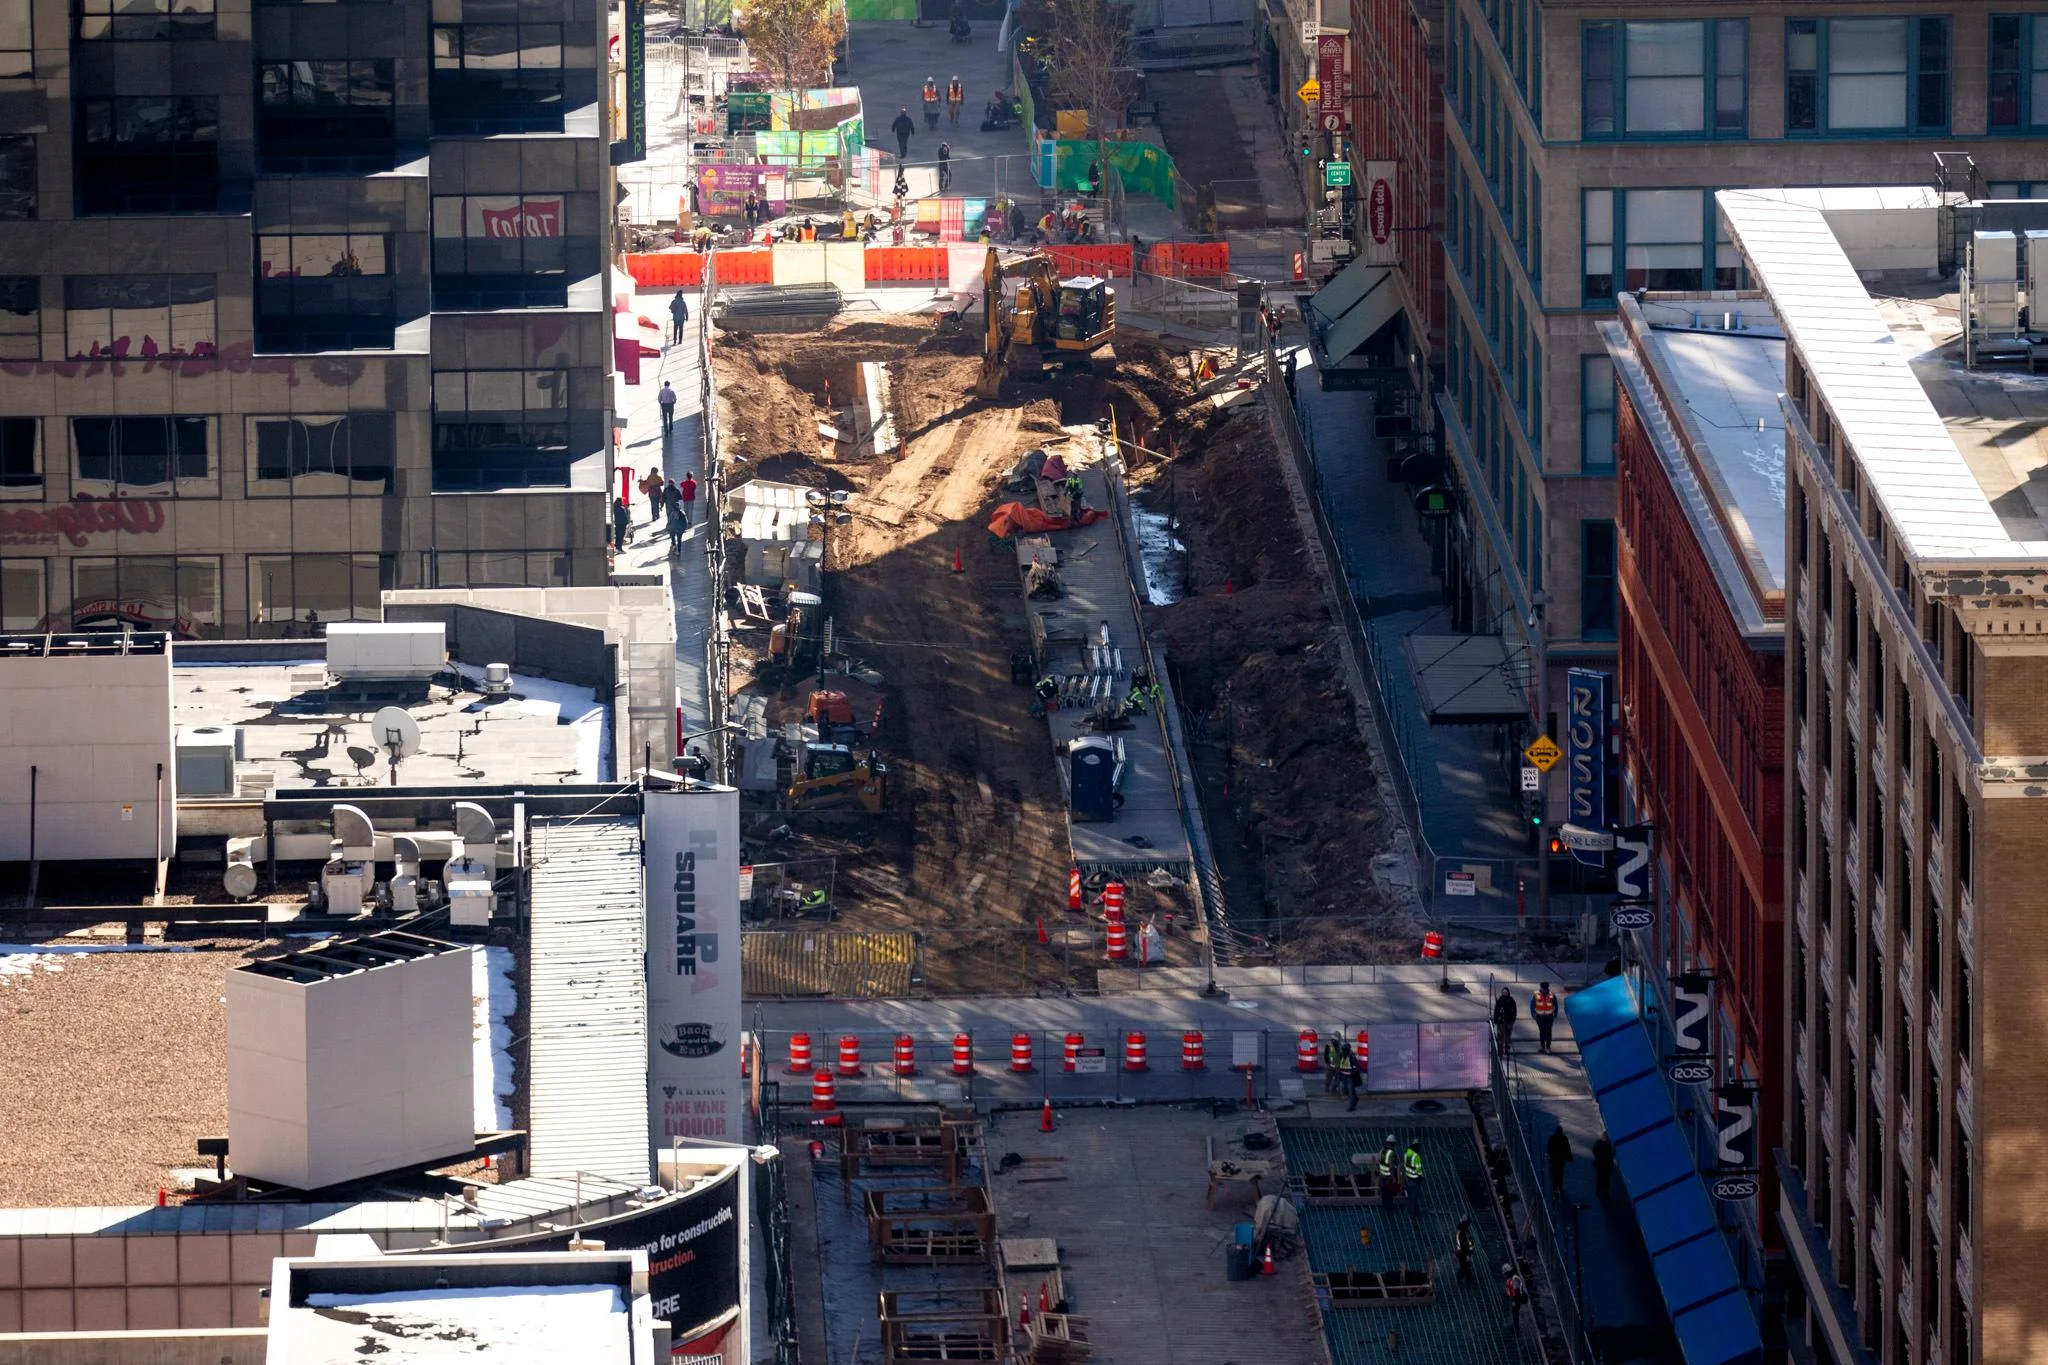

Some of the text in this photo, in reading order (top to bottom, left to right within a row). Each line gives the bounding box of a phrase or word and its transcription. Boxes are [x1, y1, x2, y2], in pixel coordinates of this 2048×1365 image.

[1320, 46, 1343, 54] DENVER
[1322, 80, 1332, 110] Tourist
[1333, 59, 1342, 108] Information
[632, 101, 644, 156] Juice
[1571, 686, 1593, 818] ROSS
[1585, 837, 1610, 846] LESS
[674, 851, 697, 976] SQUARE
[1616, 912, 1650, 926] ROSS
[678, 1026, 709, 1036] Back
[680, 1045, 709, 1055] East
[1674, 1068, 1709, 1080] ROSS
[1718, 1183, 1753, 1196] ROSS
[660, 1233, 677, 1251] for
[678, 1205, 733, 1244] construction,
[650, 1250, 696, 1275] truction.
[652, 1294, 680, 1319] ORE
